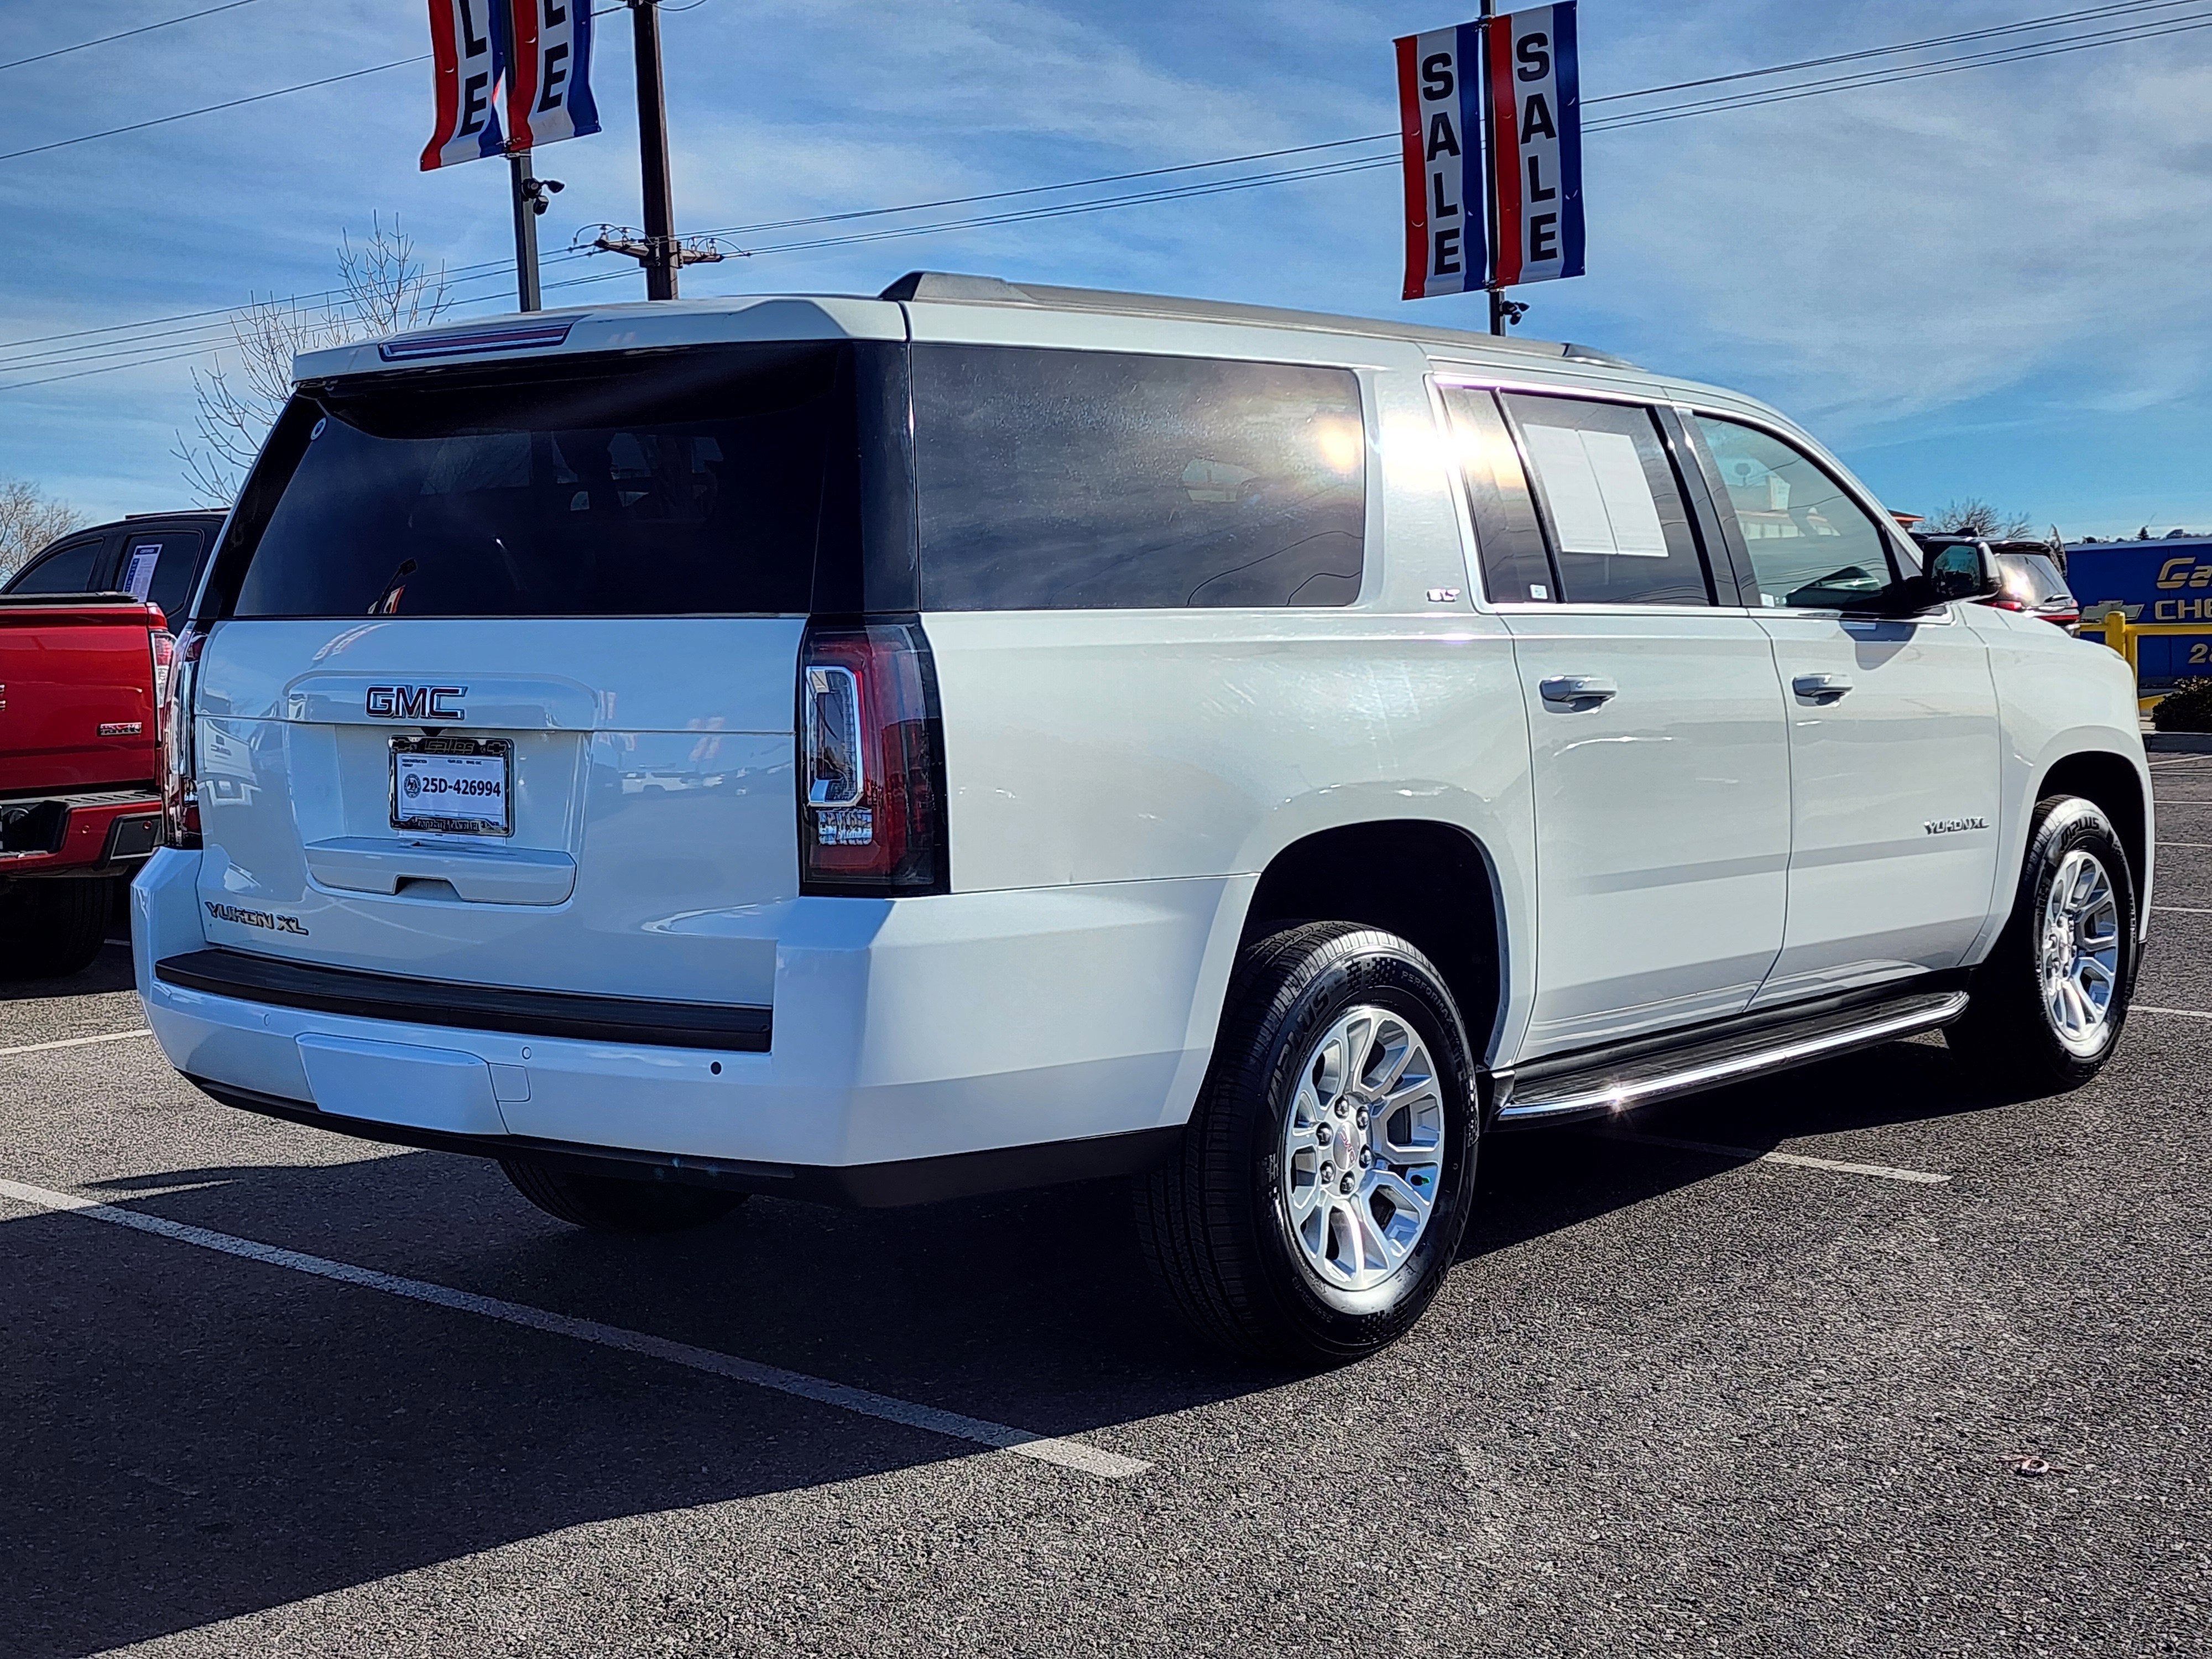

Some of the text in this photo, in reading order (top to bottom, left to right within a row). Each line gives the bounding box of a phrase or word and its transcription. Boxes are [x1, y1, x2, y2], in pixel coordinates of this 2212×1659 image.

[1422, 53, 1460, 276] SALE
[1517, 32, 1558, 263] SALE
[2188, 643, 2212, 664] 2
[366, 685, 468, 720] GMC
[422, 776, 501, 797] 25D-426994
[205, 901, 310, 936] YUKON XL
